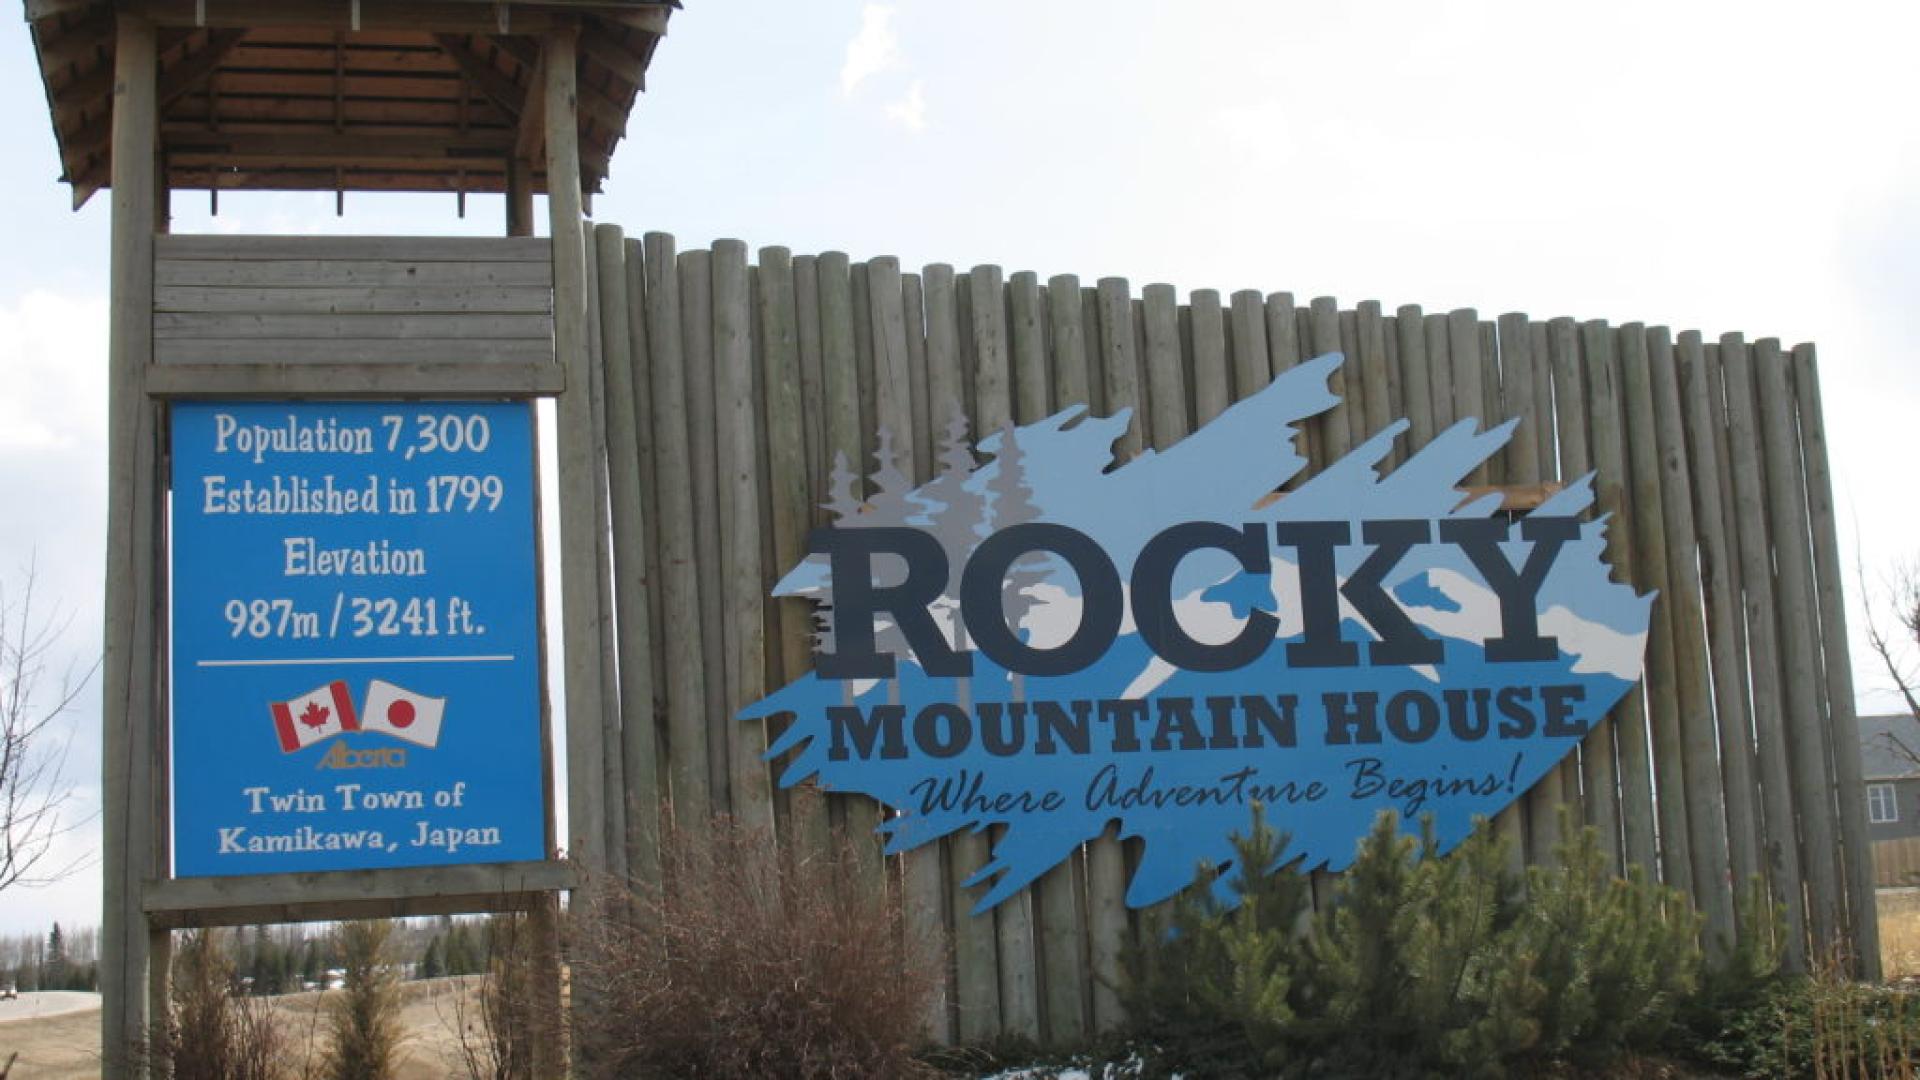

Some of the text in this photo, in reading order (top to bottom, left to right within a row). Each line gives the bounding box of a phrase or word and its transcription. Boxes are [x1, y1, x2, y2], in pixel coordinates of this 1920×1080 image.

[214, 414, 490, 463] Population 7,300
[203, 475, 503, 514] Established in 1799
[284, 537, 426, 576] Elevation
[225, 599, 320, 638] 987m
[352, 597, 438, 637] 3241
[447, 596, 485, 635] ft.
[810, 518, 1582, 679] ROCKY
[826, 685, 1589, 761] MOUNTAIN HOUSE
[243, 782, 466, 813] Twin Town of
[910, 752, 1523, 818] Where Adventure Begins!
[218, 821, 501, 854] Kamikawa, Japan
